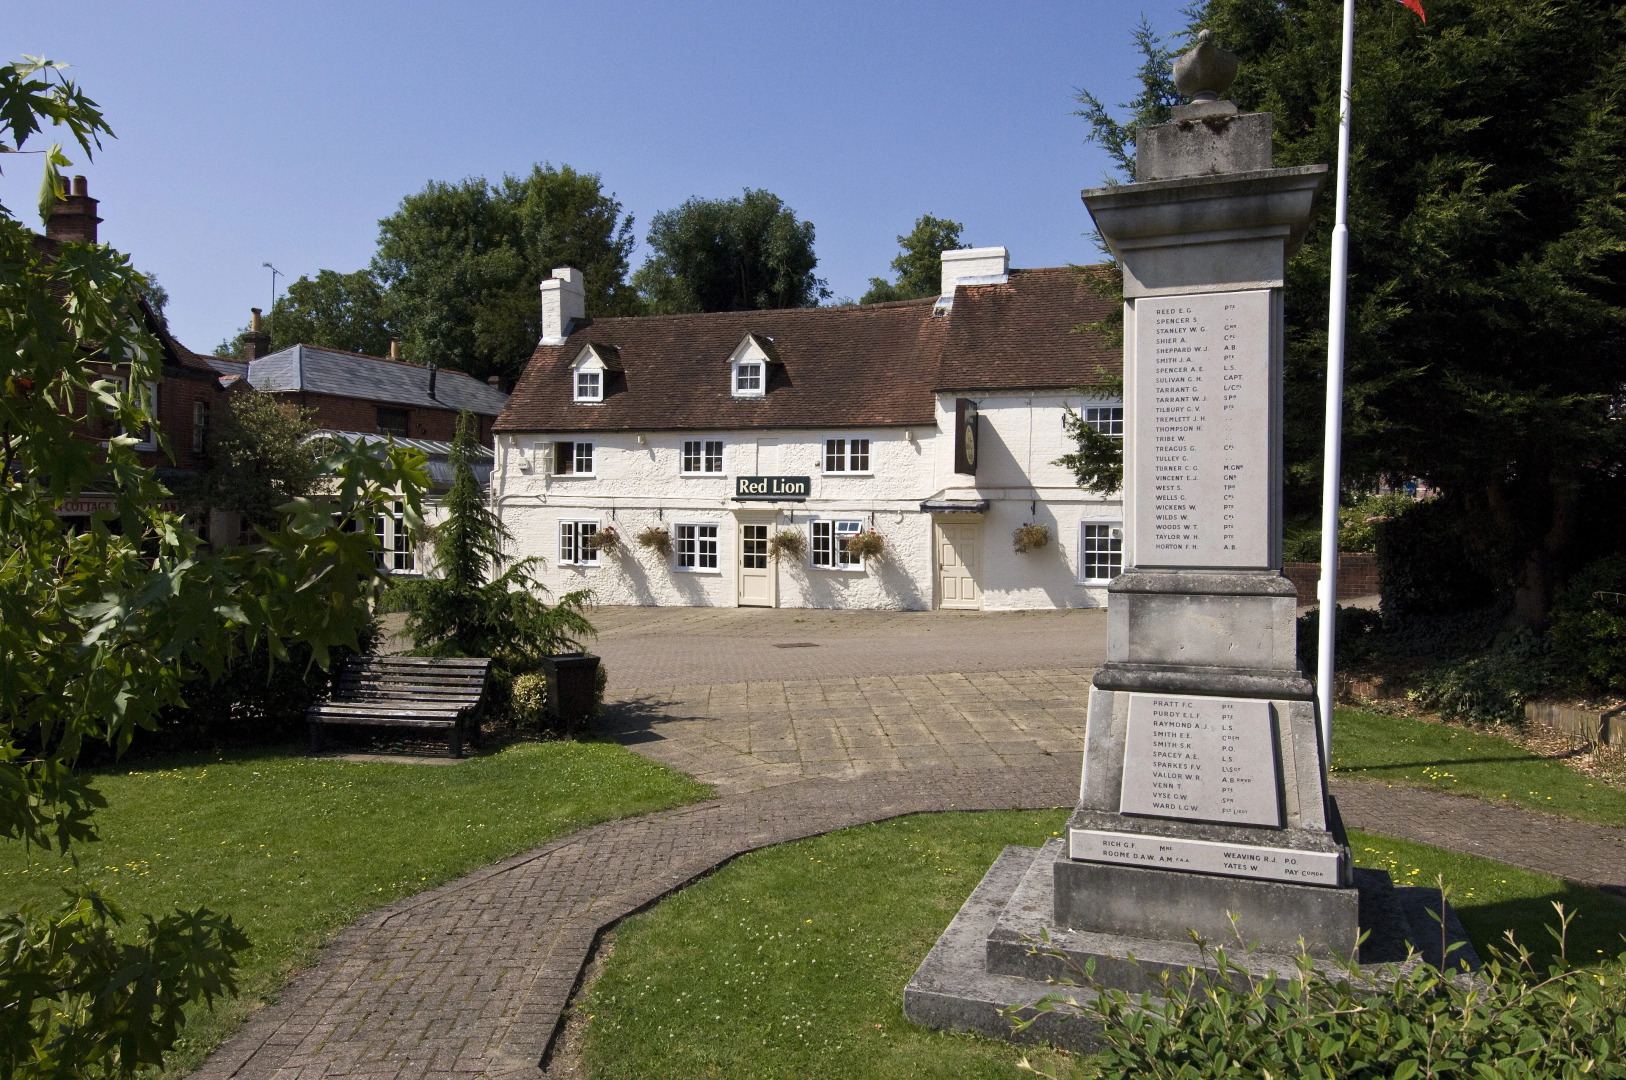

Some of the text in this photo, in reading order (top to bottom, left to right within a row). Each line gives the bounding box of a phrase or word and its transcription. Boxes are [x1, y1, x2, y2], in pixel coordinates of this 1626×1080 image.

[740, 478, 805, 493] Red Lion
[1154, 721, 1192, 729] RAYMOND
[1224, 853, 1260, 861] WEAVING
